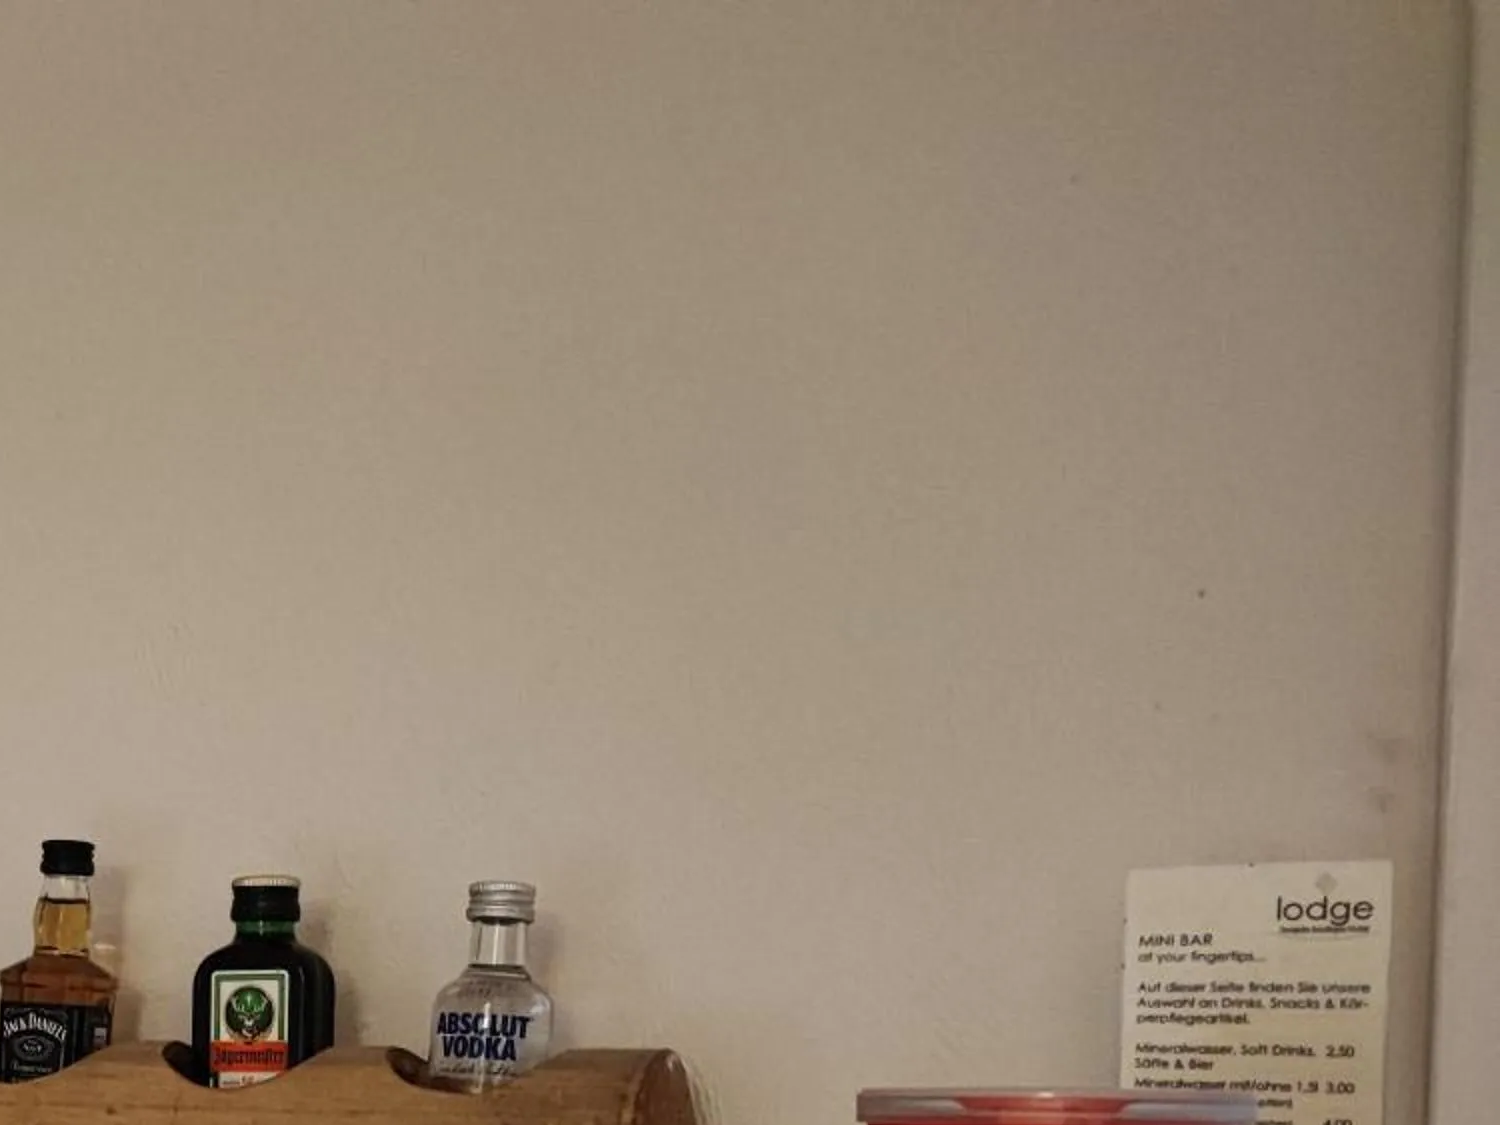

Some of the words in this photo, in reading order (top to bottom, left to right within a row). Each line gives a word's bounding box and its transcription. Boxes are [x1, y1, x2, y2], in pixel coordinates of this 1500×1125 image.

[1276, 896, 1374, 927] lodge
[1139, 933, 1175, 947] MINI
[1180, 932, 1213, 947] BAR
[1138, 952, 1153, 963] at
[1155, 953, 1187, 966] your
[1137, 981, 1162, 994] Auf
[1164, 981, 1206, 994] dieser
[1209, 981, 1244, 994] Seite
[1248, 981, 1295, 994] finden
[1298, 981, 1319, 994] Sie
[1137, 997, 1195, 1010] Auswahl
[1198, 999, 1218, 1009] an
[1269, 997, 1320, 1010] Snacks
[437, 1011, 535, 1039] ABSOLUT
[442, 1035, 517, 1061] VODKA
